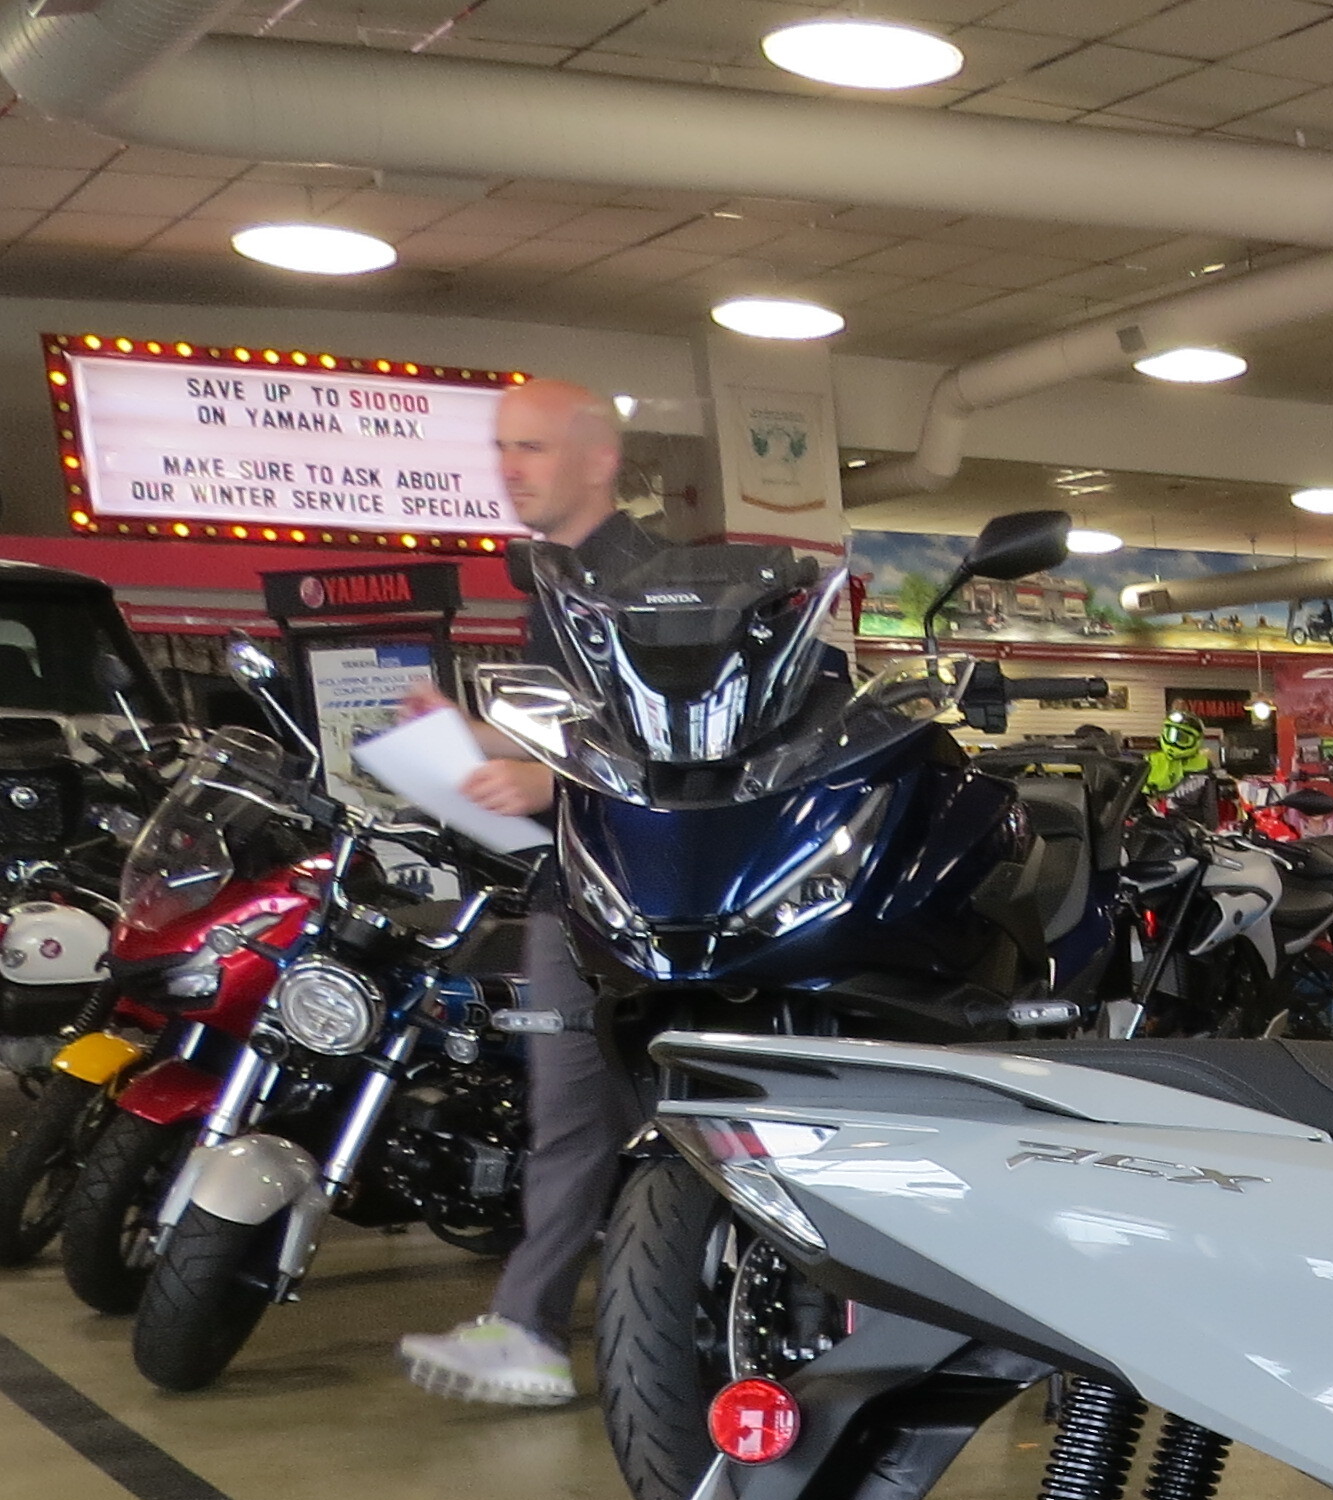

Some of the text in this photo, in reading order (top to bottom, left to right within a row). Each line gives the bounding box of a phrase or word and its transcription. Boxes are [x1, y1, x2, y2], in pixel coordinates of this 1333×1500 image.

[187, 378, 245, 401] SAVE
[264, 382, 291, 402] UP
[311, 386, 340, 407] TO
[198, 405, 226, 426] ON
[245, 408, 342, 433] YAMAHA
[163, 456, 462, 492] MAKE SURE TO ASK ABOUT
[132, 481, 501, 519] OUR WINTER SERVICE SPECIALS
[323, 573, 413, 605] YAMAHA
[644, 592, 702, 605] HONDA
[1005, 1140, 1273, 1193] PCX
